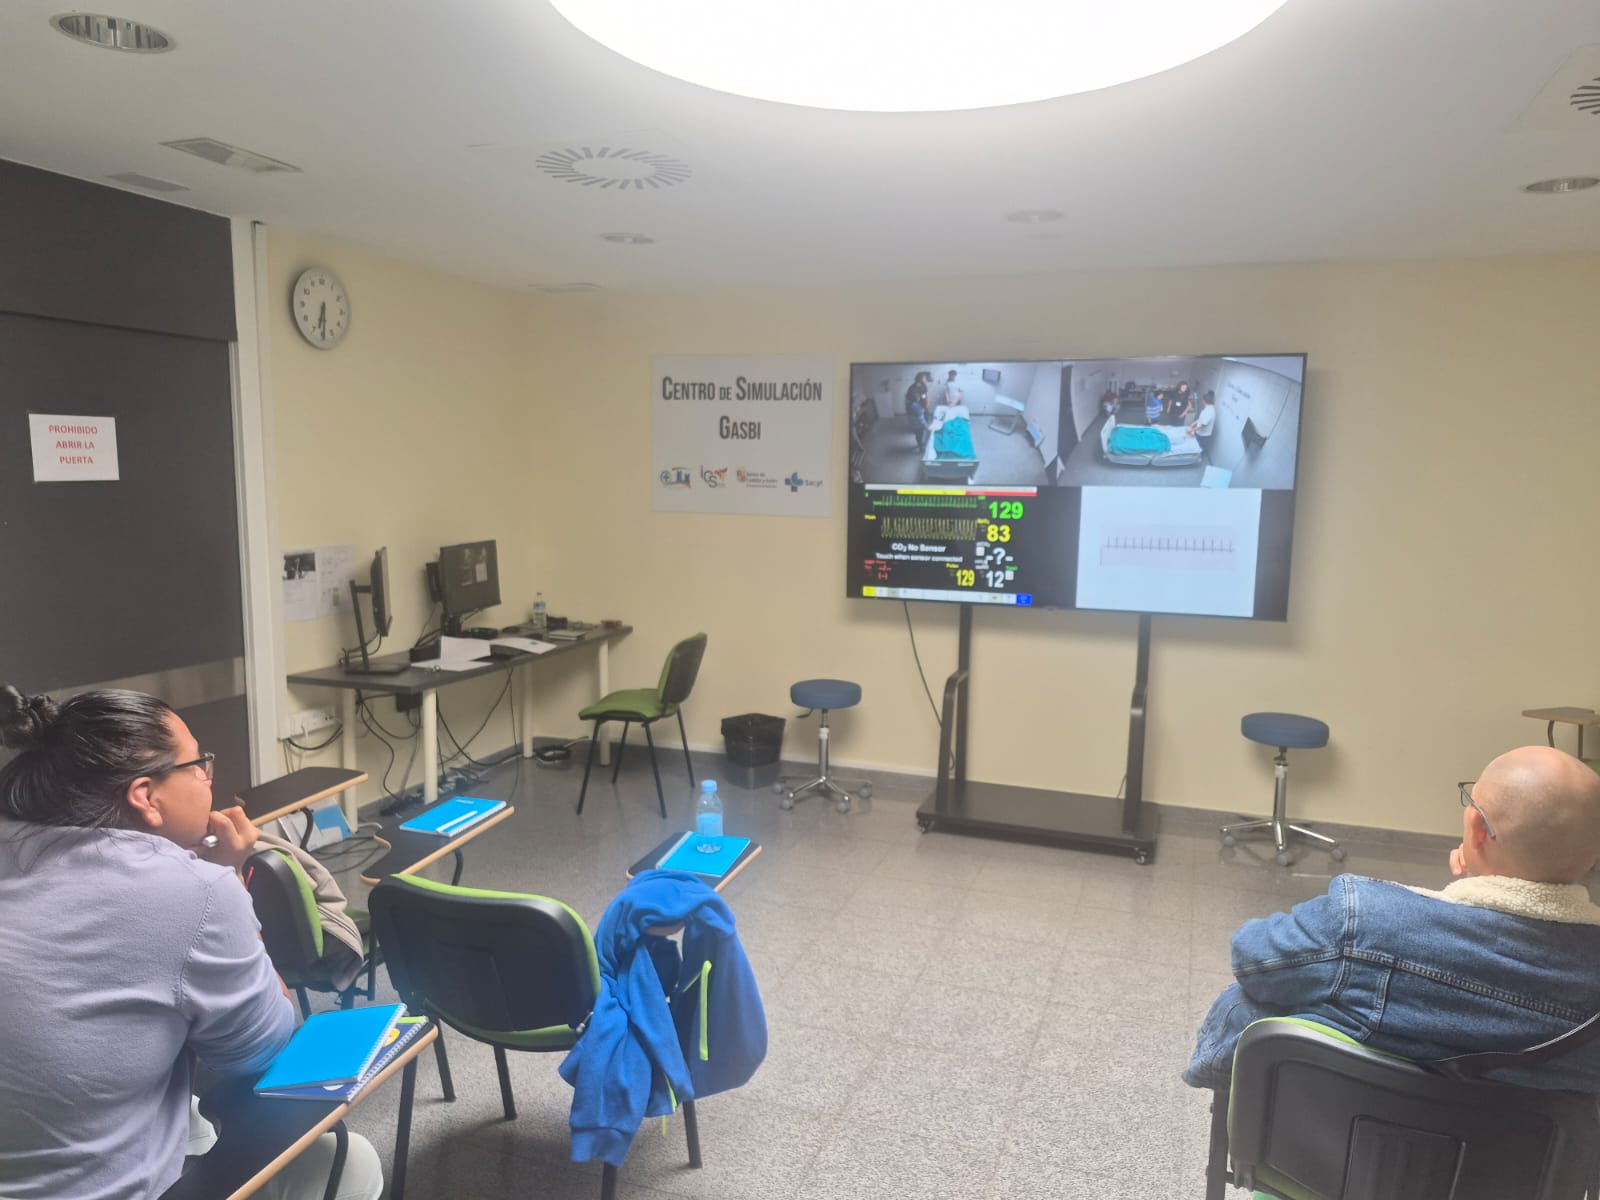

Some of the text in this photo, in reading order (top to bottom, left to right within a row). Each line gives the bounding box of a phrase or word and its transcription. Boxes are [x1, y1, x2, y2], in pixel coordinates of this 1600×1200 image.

[662, 376, 823, 401] CENTRO DE SIMULACIÓN
[48, 424, 98, 435] PROHIBIDO
[719, 415, 762, 440] GASBI
[55, 440, 95, 450] ABRIR LA
[59, 456, 94, 465] PUERTA
[988, 501, 1024, 519] 129
[986, 524, 1011, 543] 83
[907, 543, 919, 552] No
[919, 544, 946, 553] Sensor
[956, 569, 975, 587] 129
[986, 570, 1005, 588] 12
